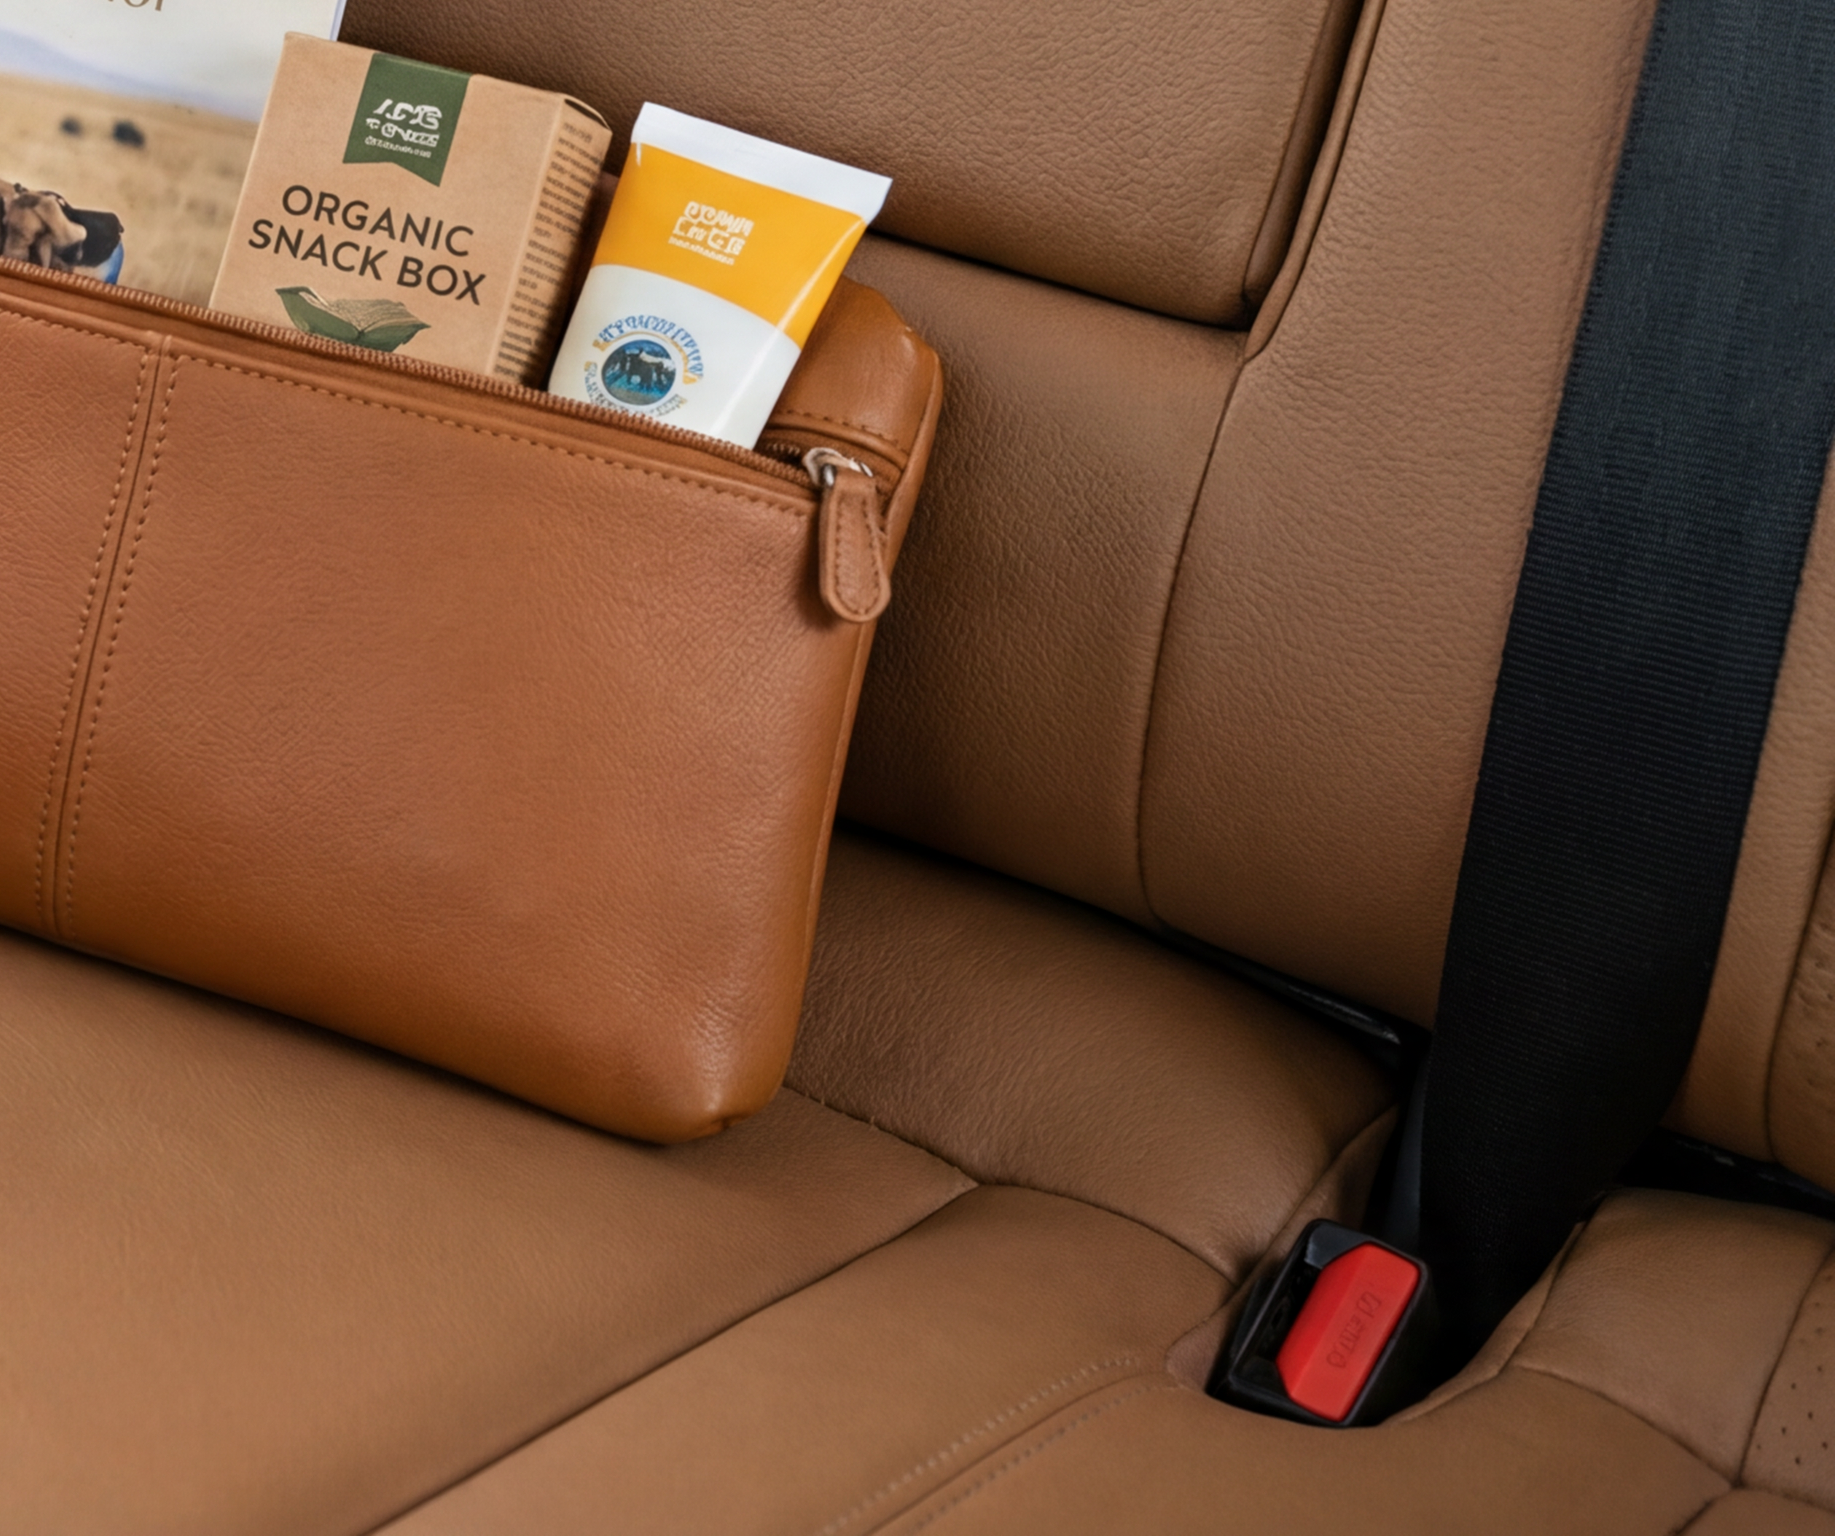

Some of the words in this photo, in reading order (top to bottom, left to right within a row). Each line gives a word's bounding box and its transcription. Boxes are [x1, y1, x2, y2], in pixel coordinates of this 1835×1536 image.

[282, 184, 474, 257] ORGANIC
[248, 218, 388, 281] SNACK
[396, 255, 486, 306] BOX
